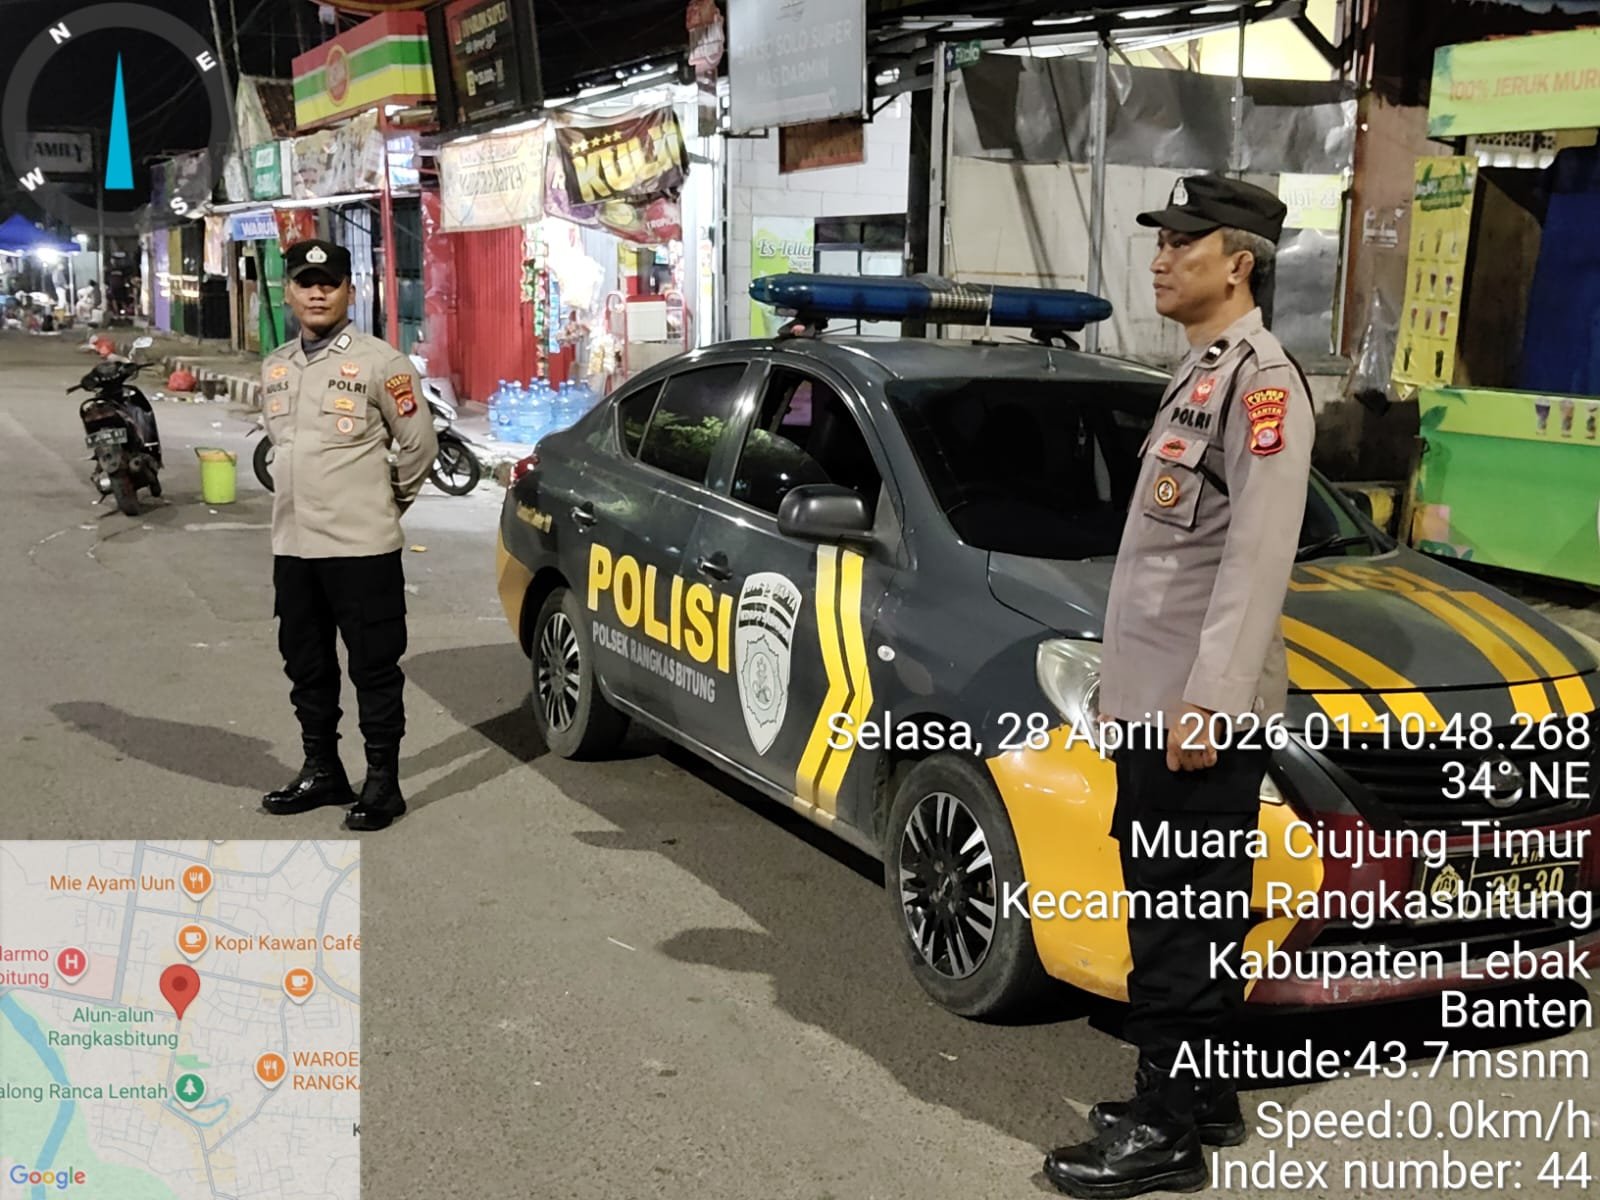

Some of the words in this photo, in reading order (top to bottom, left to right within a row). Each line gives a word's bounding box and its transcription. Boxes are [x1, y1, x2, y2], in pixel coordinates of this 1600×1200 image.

[1493, 73, 1547, 97] JERUK
[1552, 68, 1600, 93] MUR
[328, 379, 367, 394] POLRI
[1171, 407, 1212, 430] POLRI
[587, 543, 733, 674] POLISI
[592, 621, 629, 659] POLSEK
[630, 640, 716, 704] RANGKASBITUNG
